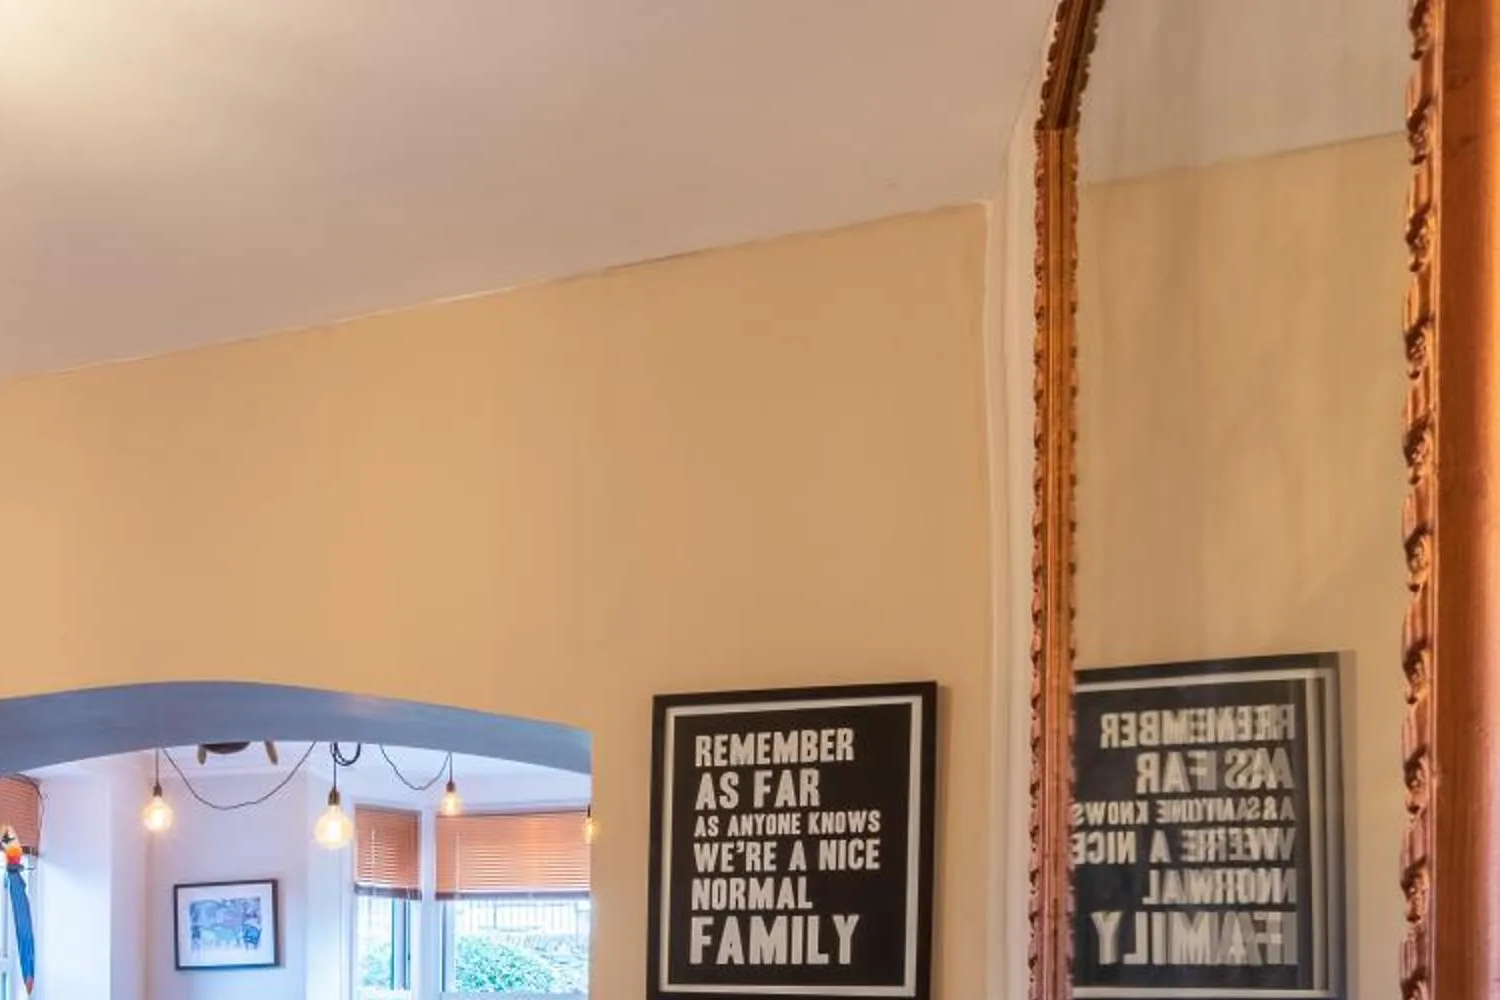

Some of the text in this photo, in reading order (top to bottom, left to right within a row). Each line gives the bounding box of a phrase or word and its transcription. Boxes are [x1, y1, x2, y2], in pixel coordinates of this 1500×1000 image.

[694, 727, 855, 767] REMEMBER
[694, 768, 820, 811] AS FAR
[693, 810, 881, 838] AS ANYONE KNOWS
[693, 838, 881, 873] WE'RE A NICE
[691, 875, 813, 911] NORMAL
[689, 913, 860, 966] FAMILY
